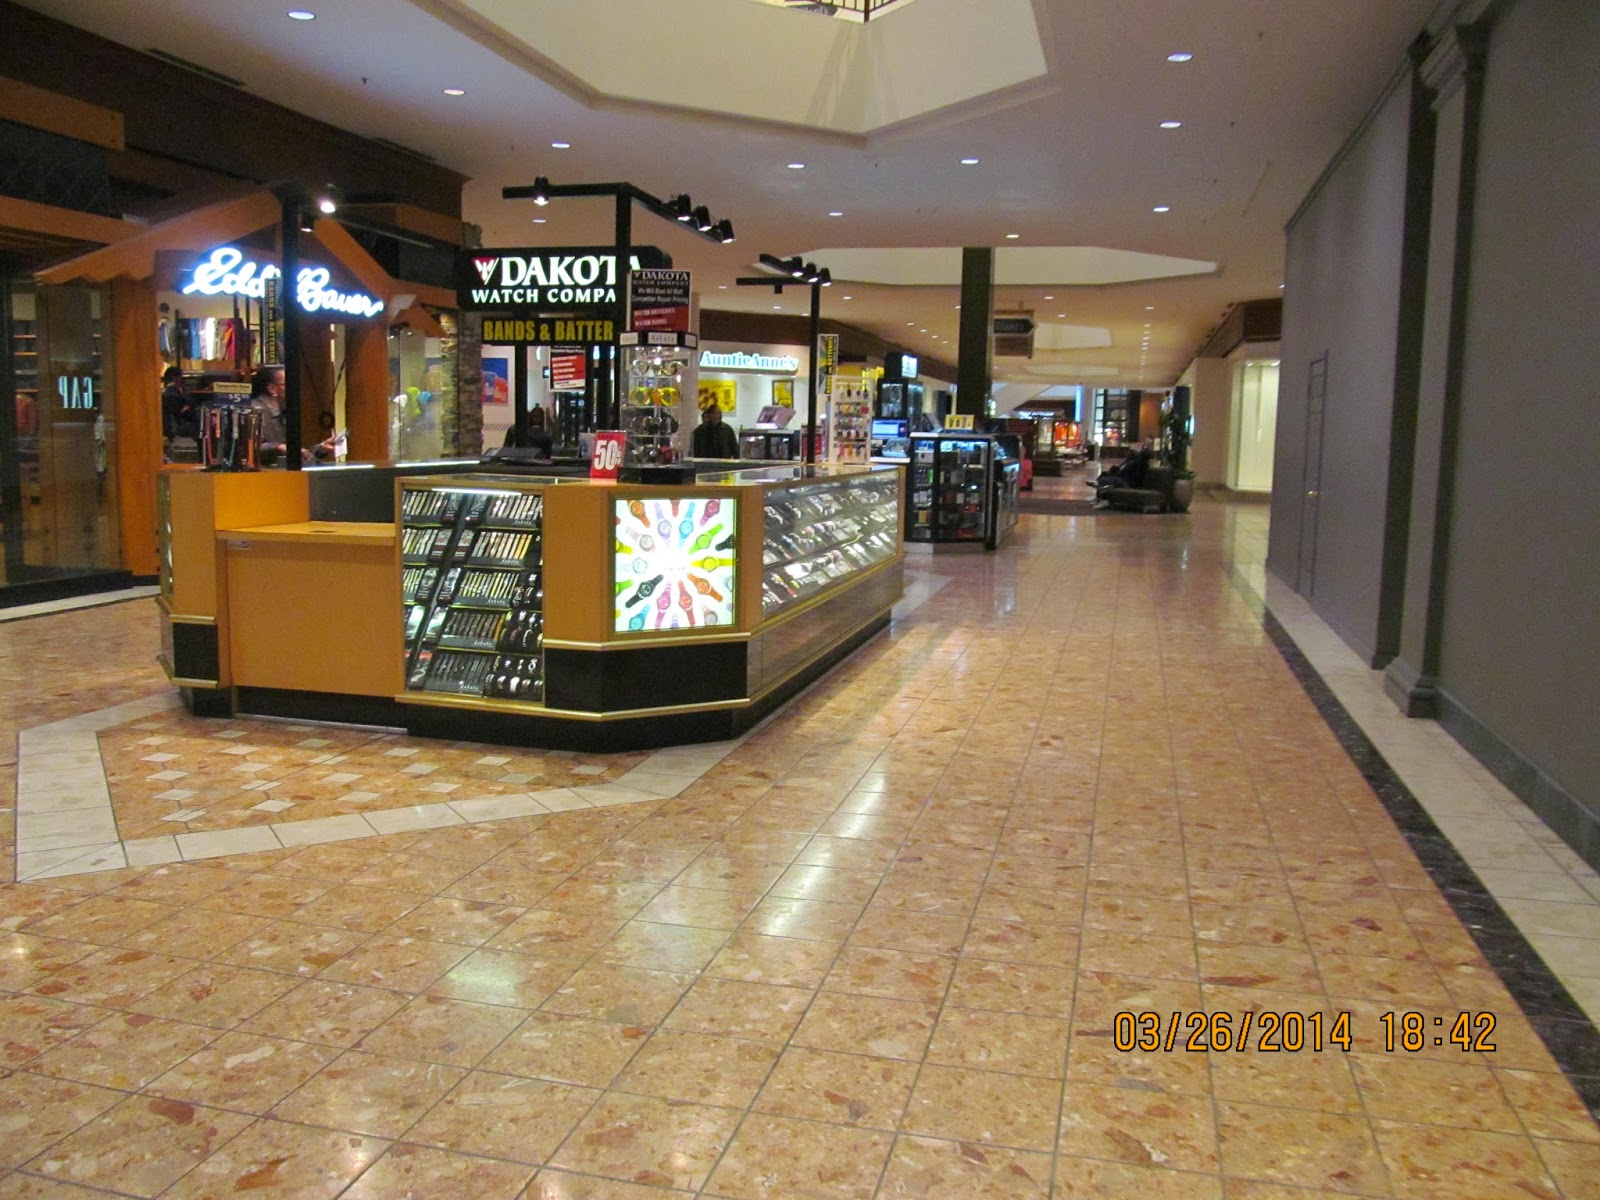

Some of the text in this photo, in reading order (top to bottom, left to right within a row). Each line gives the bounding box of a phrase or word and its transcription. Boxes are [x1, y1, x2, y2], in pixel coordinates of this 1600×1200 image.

[642, 271, 688, 280] DAKOTA
[297, 267, 384, 317] Bauer
[471, 289, 539, 304] WATCH
[483, 320, 536, 342] BANDS
[539, 323, 551, 342] &
[268, 321, 276, 364] BATTERIES
[701, 351, 799, 371] Auntie Anne's
